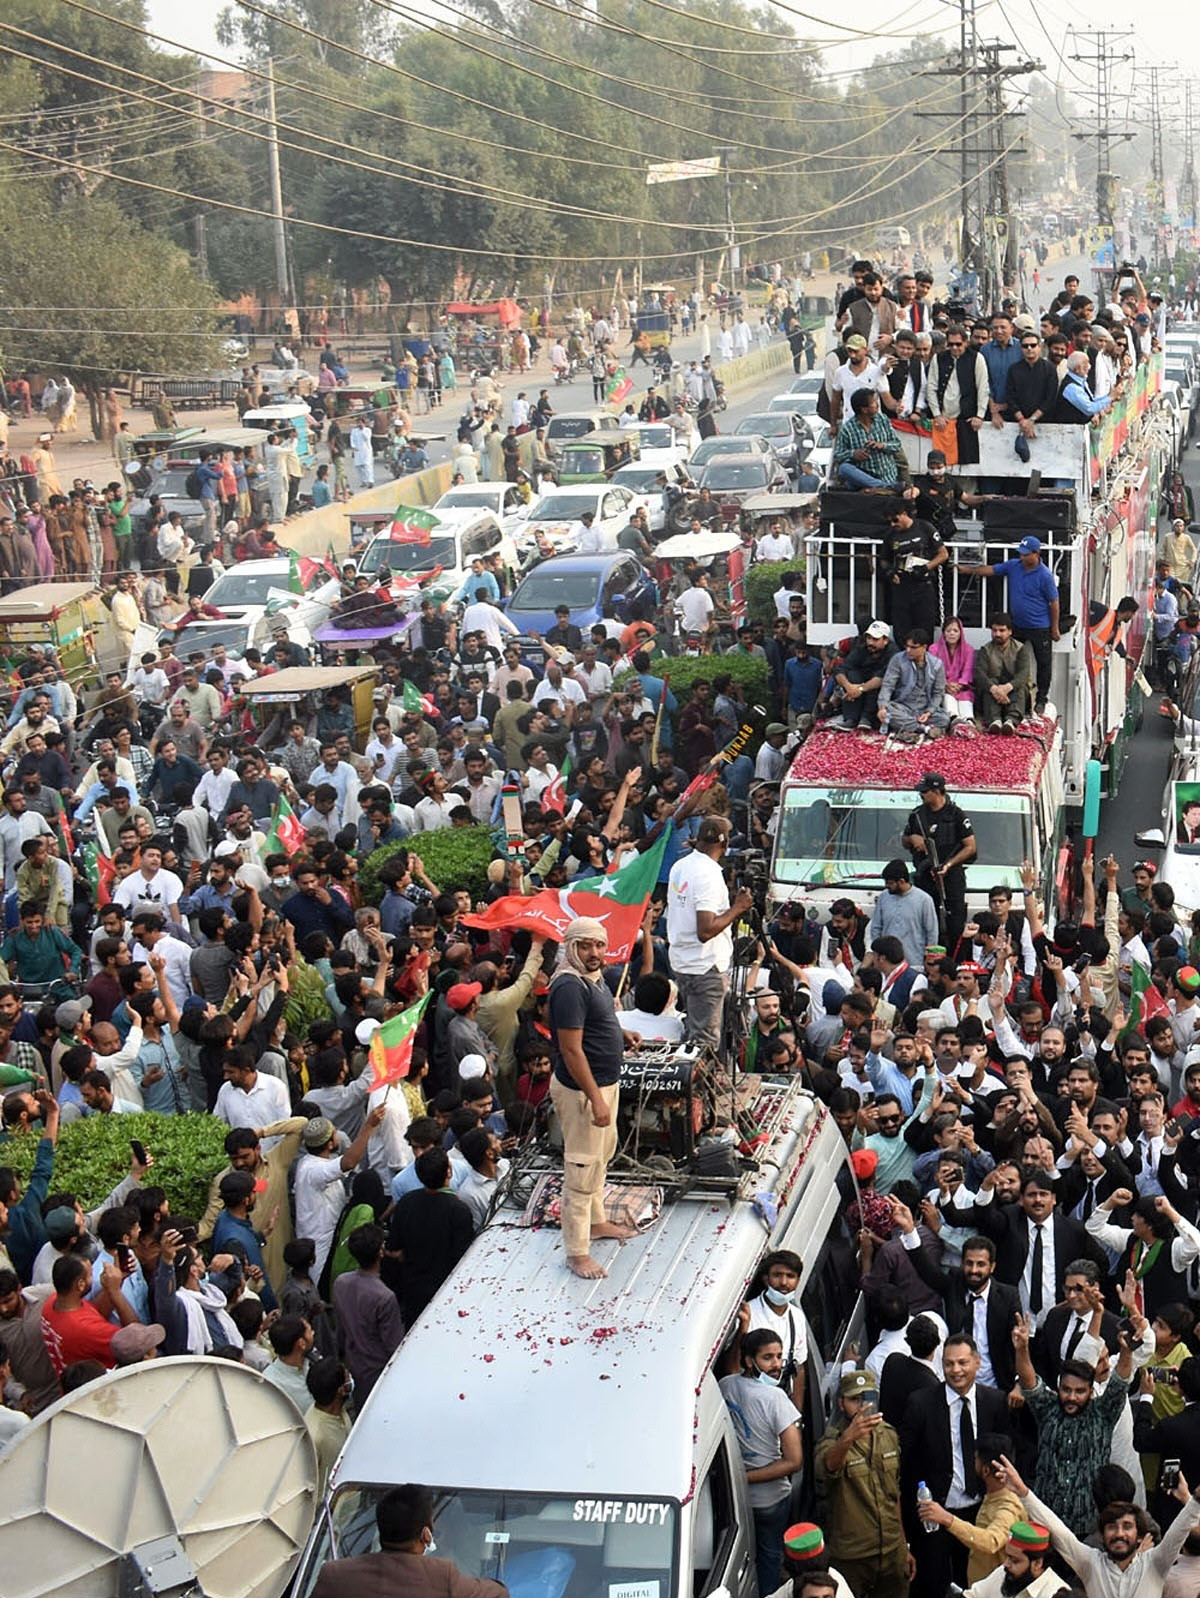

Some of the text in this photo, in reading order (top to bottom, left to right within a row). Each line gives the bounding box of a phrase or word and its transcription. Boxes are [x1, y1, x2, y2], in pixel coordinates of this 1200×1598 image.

[724, 724, 755, 762] PUNJAB
[573, 1500, 670, 1525] STAFF DUTY
